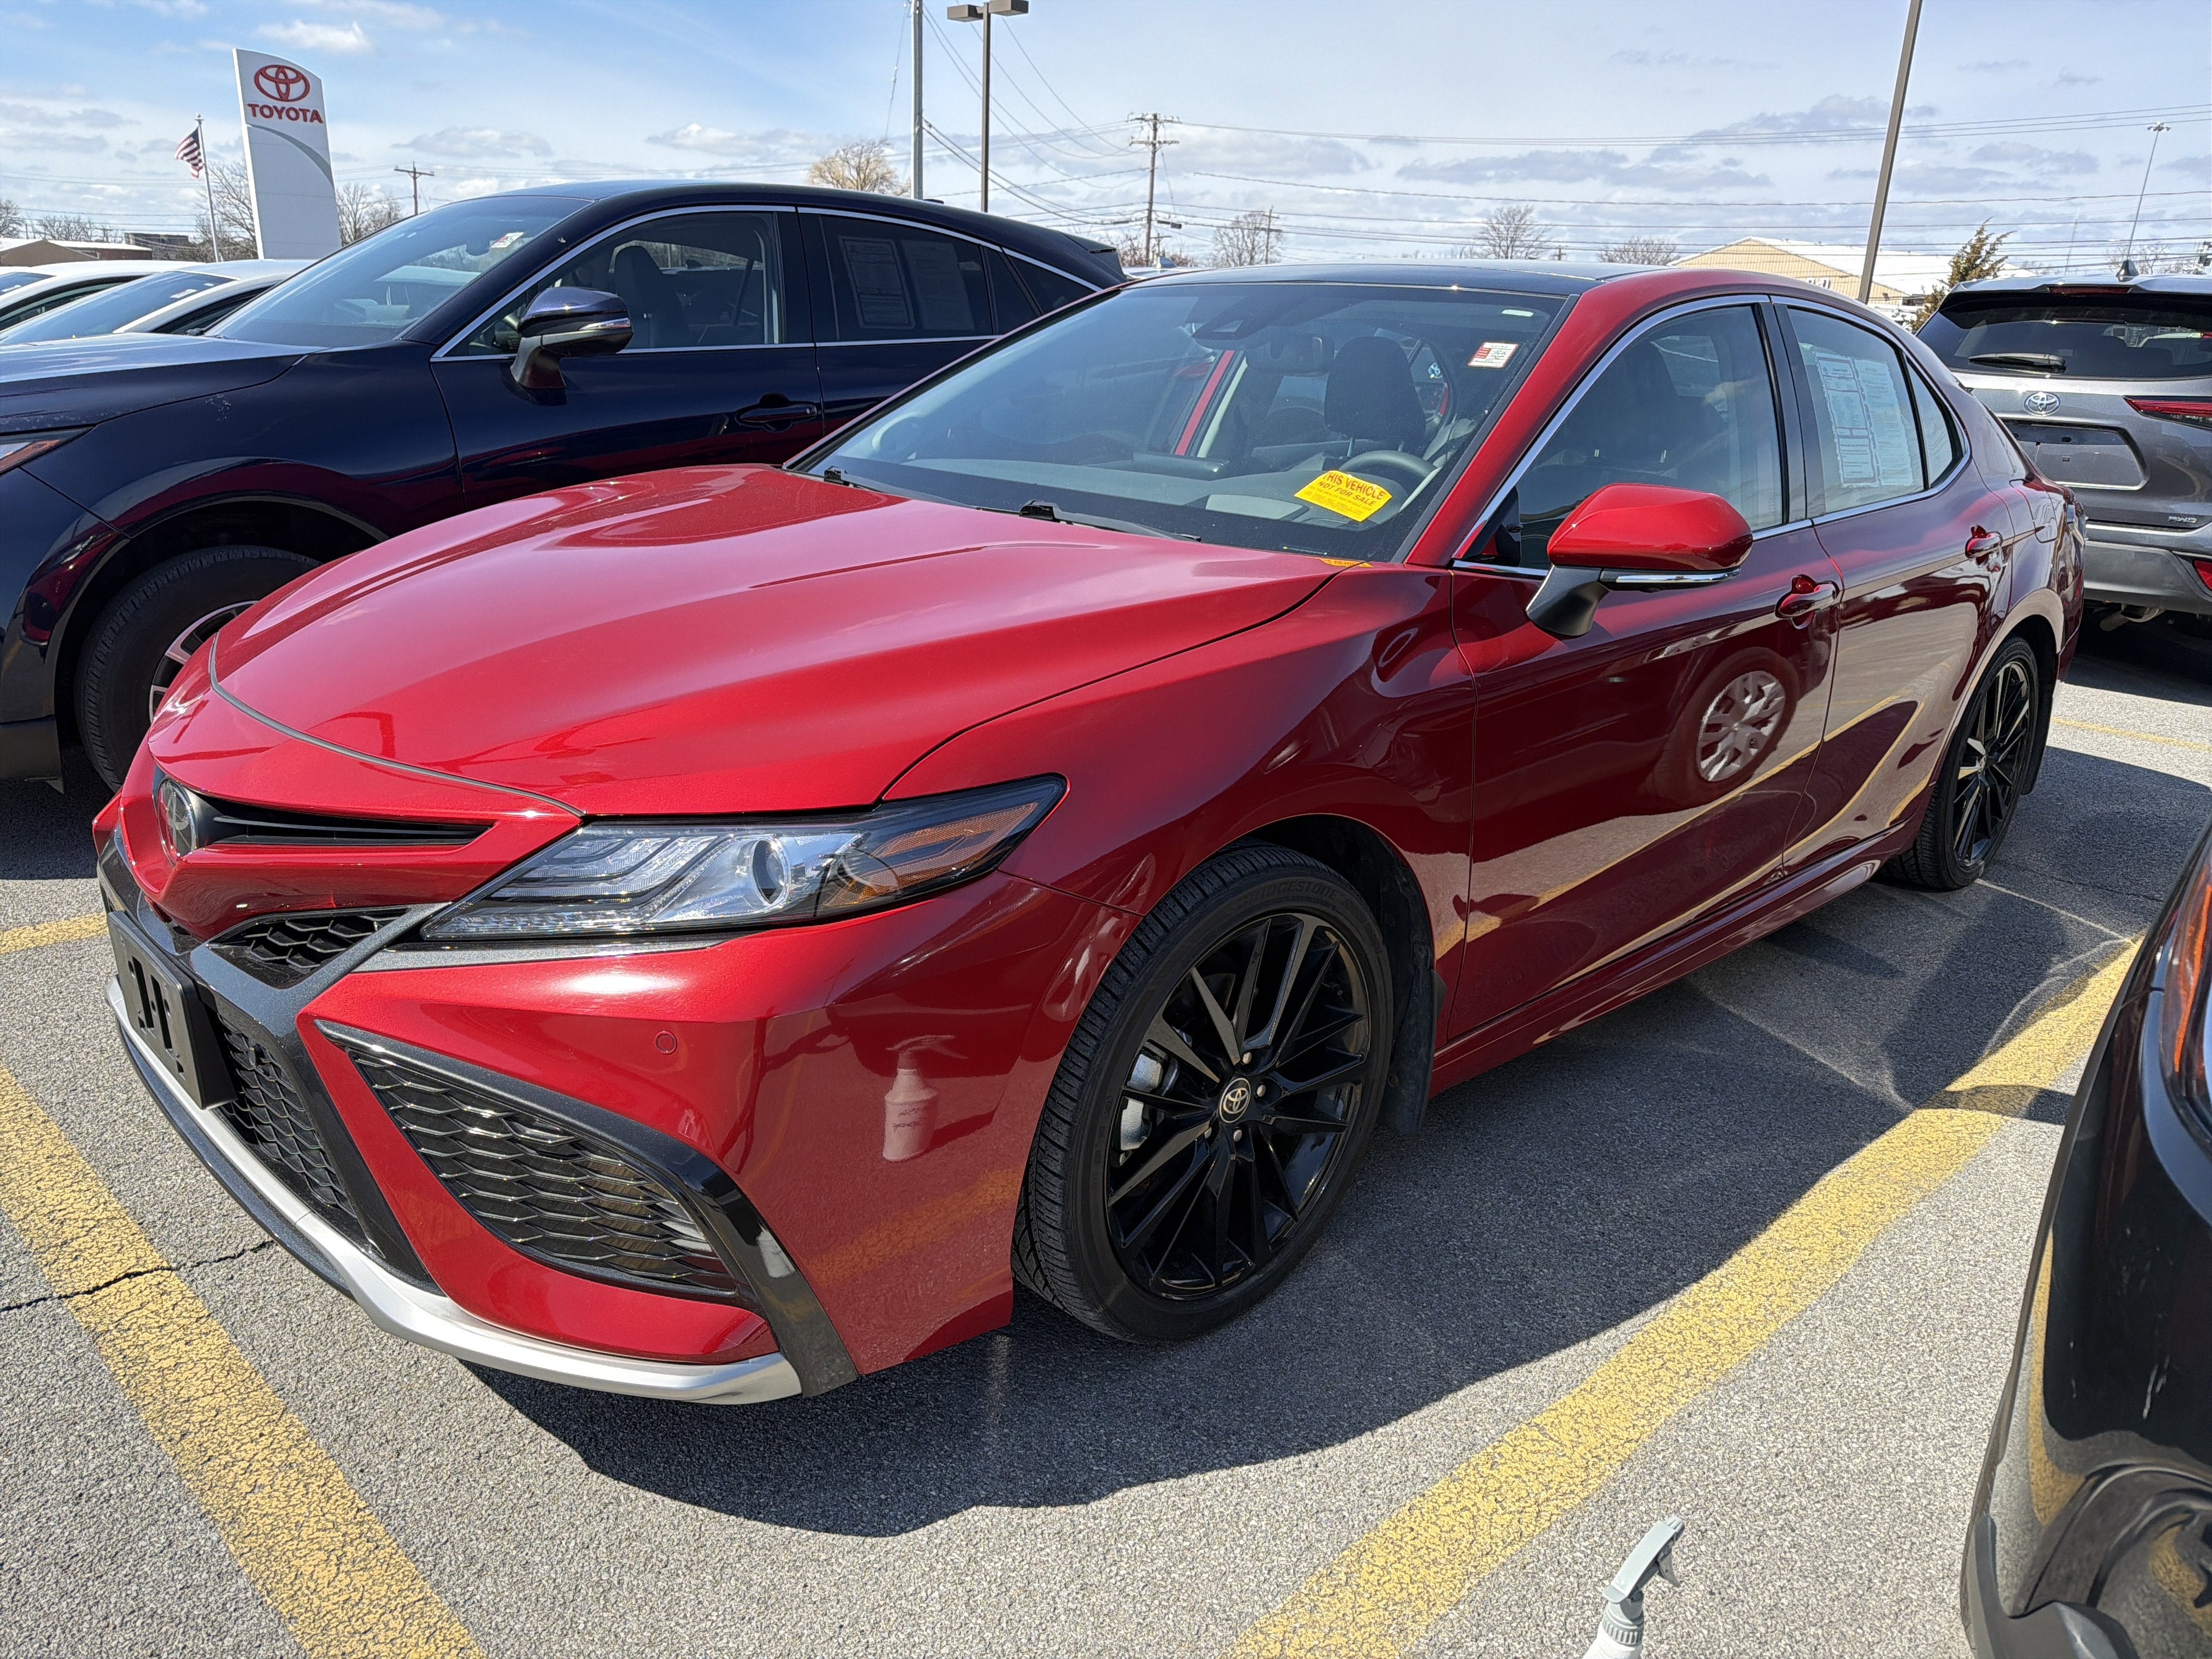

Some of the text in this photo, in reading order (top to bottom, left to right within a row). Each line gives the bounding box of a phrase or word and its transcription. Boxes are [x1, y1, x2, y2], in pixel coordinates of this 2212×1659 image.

[247, 103, 323, 123] TOYOTA
[1318, 481, 1376, 506] NOT FOR SALE
[1346, 477, 1386, 500] VEHICLE
